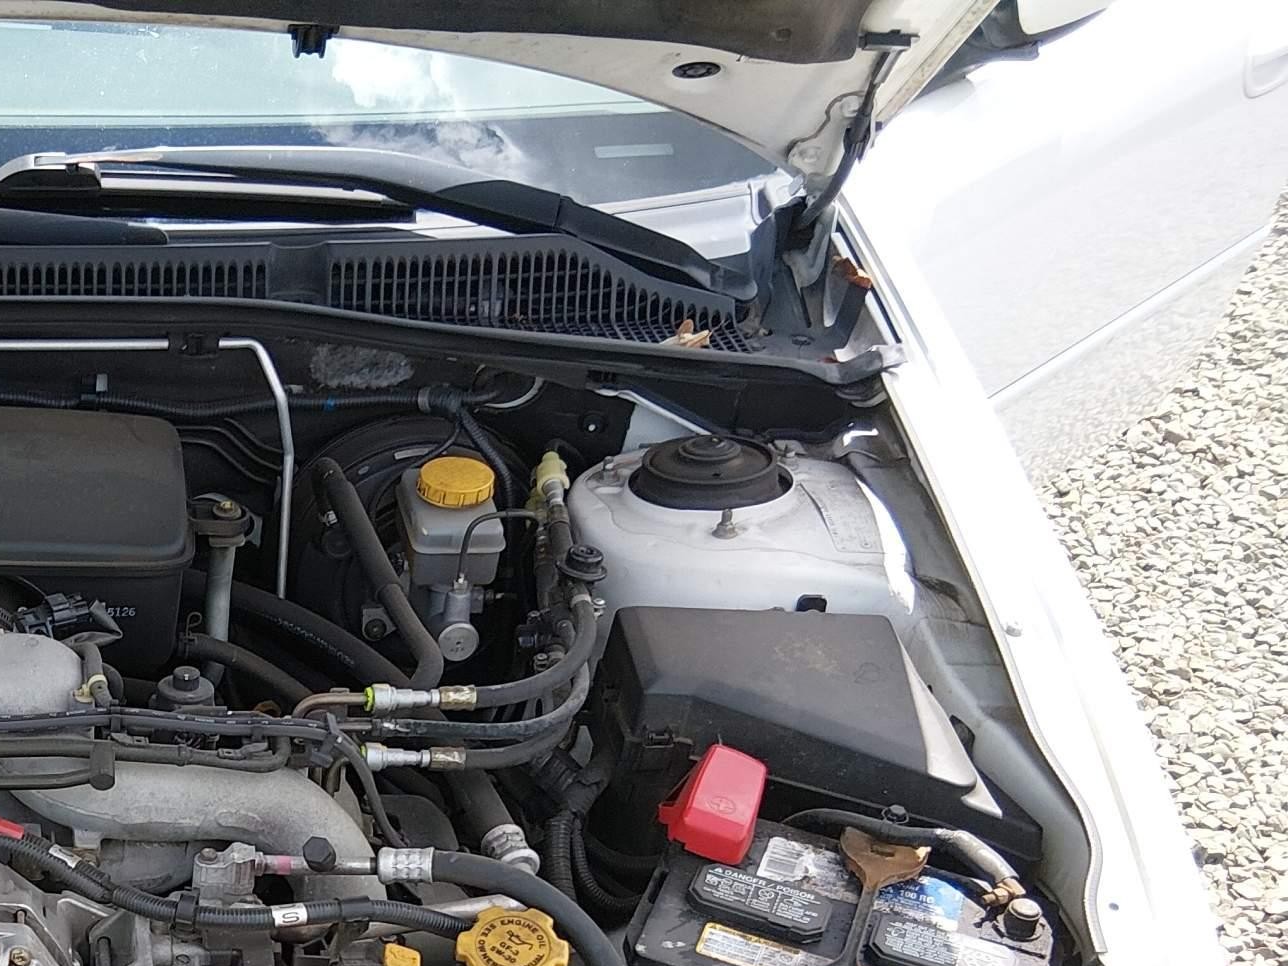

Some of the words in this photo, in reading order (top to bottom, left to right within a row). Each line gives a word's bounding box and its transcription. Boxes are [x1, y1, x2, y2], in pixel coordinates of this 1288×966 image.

[724, 869, 766, 886] DANGER
[776, 885, 815, 900] POISON
[481, 923, 497, 937] SEE
[500, 919, 539, 934] ENGINE
[536, 934, 546, 949] OIL
